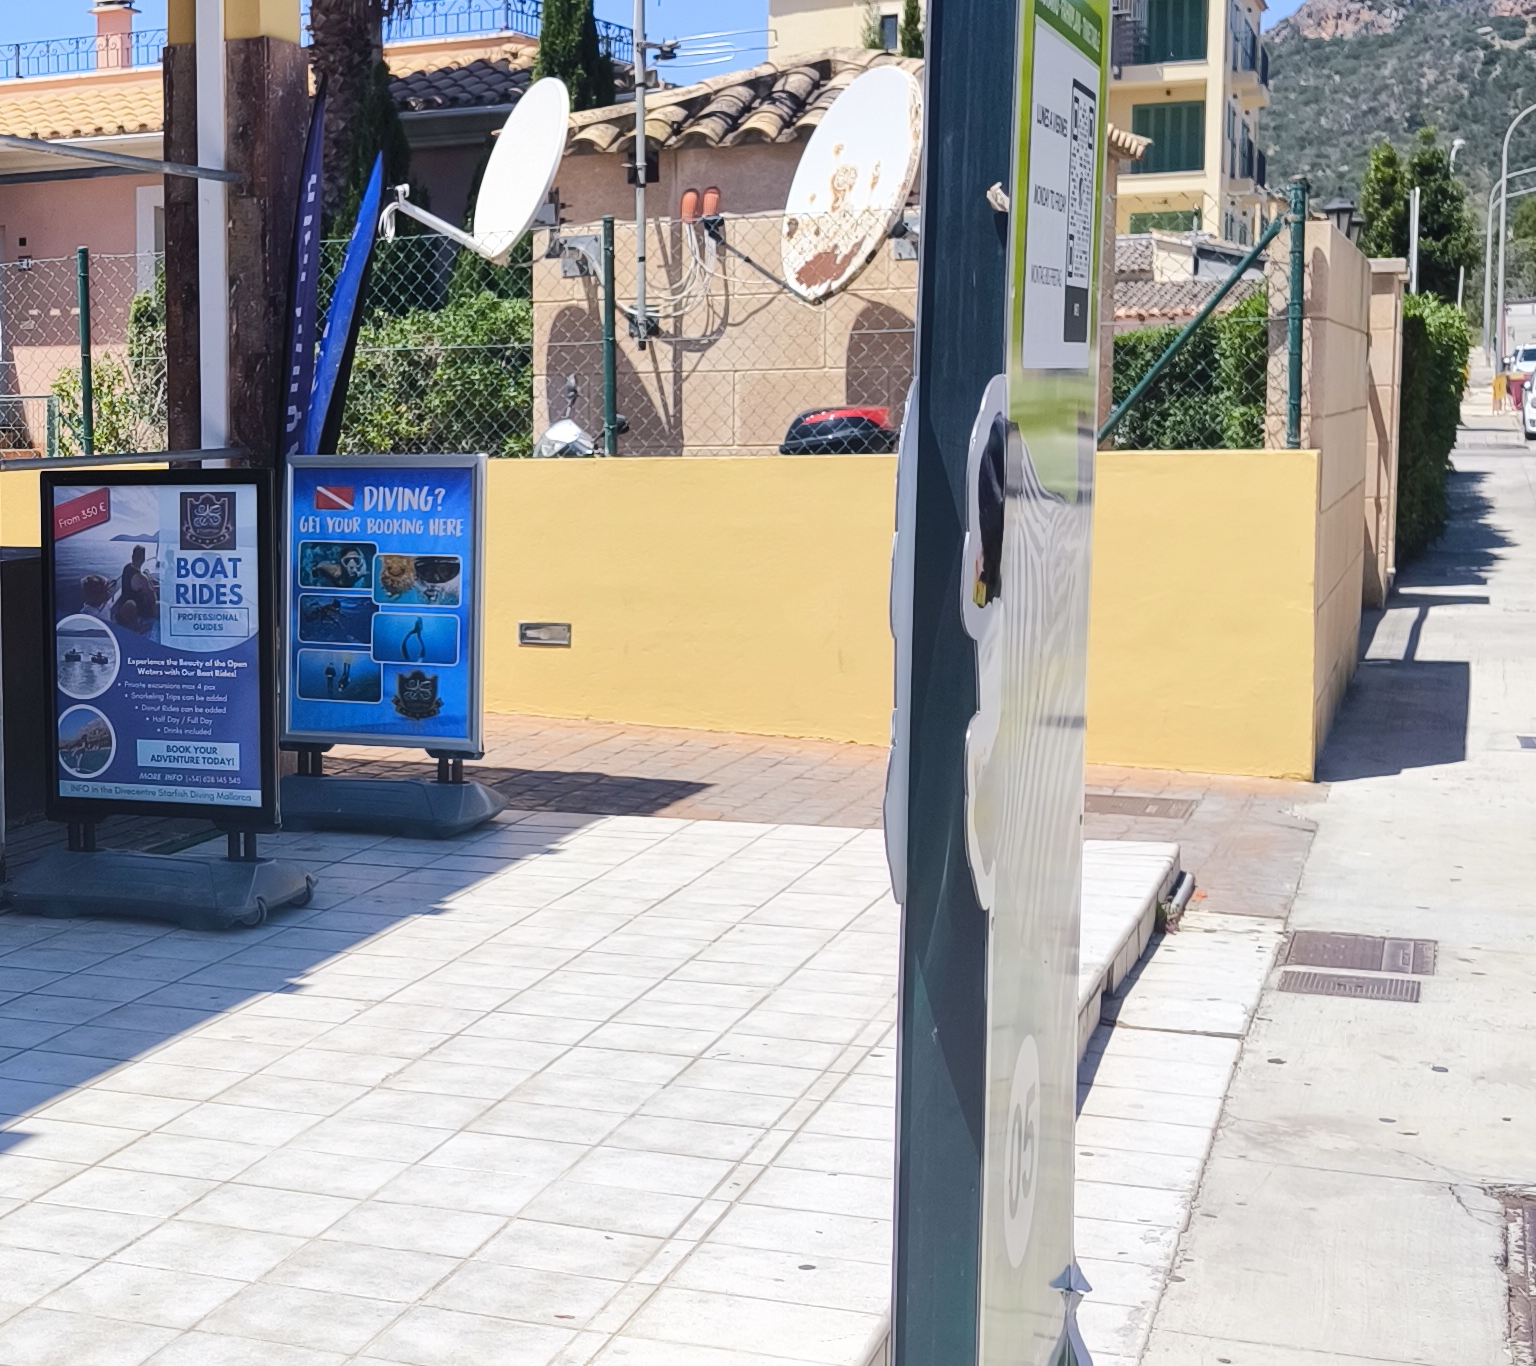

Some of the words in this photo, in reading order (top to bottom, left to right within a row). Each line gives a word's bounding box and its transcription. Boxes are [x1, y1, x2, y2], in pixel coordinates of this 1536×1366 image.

[363, 486, 446, 513] DIVING?
[58, 514, 81, 529] From
[80, 506, 98, 519] 350
[99, 501, 107, 513] €
[299, 515, 321, 533] GET
[326, 516, 361, 534] YOUR
[366, 517, 424, 535] BOOKING
[428, 518, 464, 537] HERE
[176, 557, 242, 579] BOAT
[175, 583, 243, 606] RIDES
[177, 612, 239, 622] PROFESSIONAL
[192, 623, 224, 632] GUIDES
[166, 744, 191, 754] BOOK
[193, 746, 218, 755] YOUR
[150, 754, 200, 765] ADVENTURE
[202, 756, 235, 767] TODAY!
[139, 772, 162, 781] MORE
[70, 784, 90, 793] INFO
[91, 785, 99, 793] in
[100, 785, 113, 794] the
[115, 785, 156, 796] Divecentre
[158, 788, 189, 798] Starfish
[190, 790, 214, 801] Diving
[216, 791, 252, 802] Mallorca
[1008, 1081, 1036, 1221] 05
